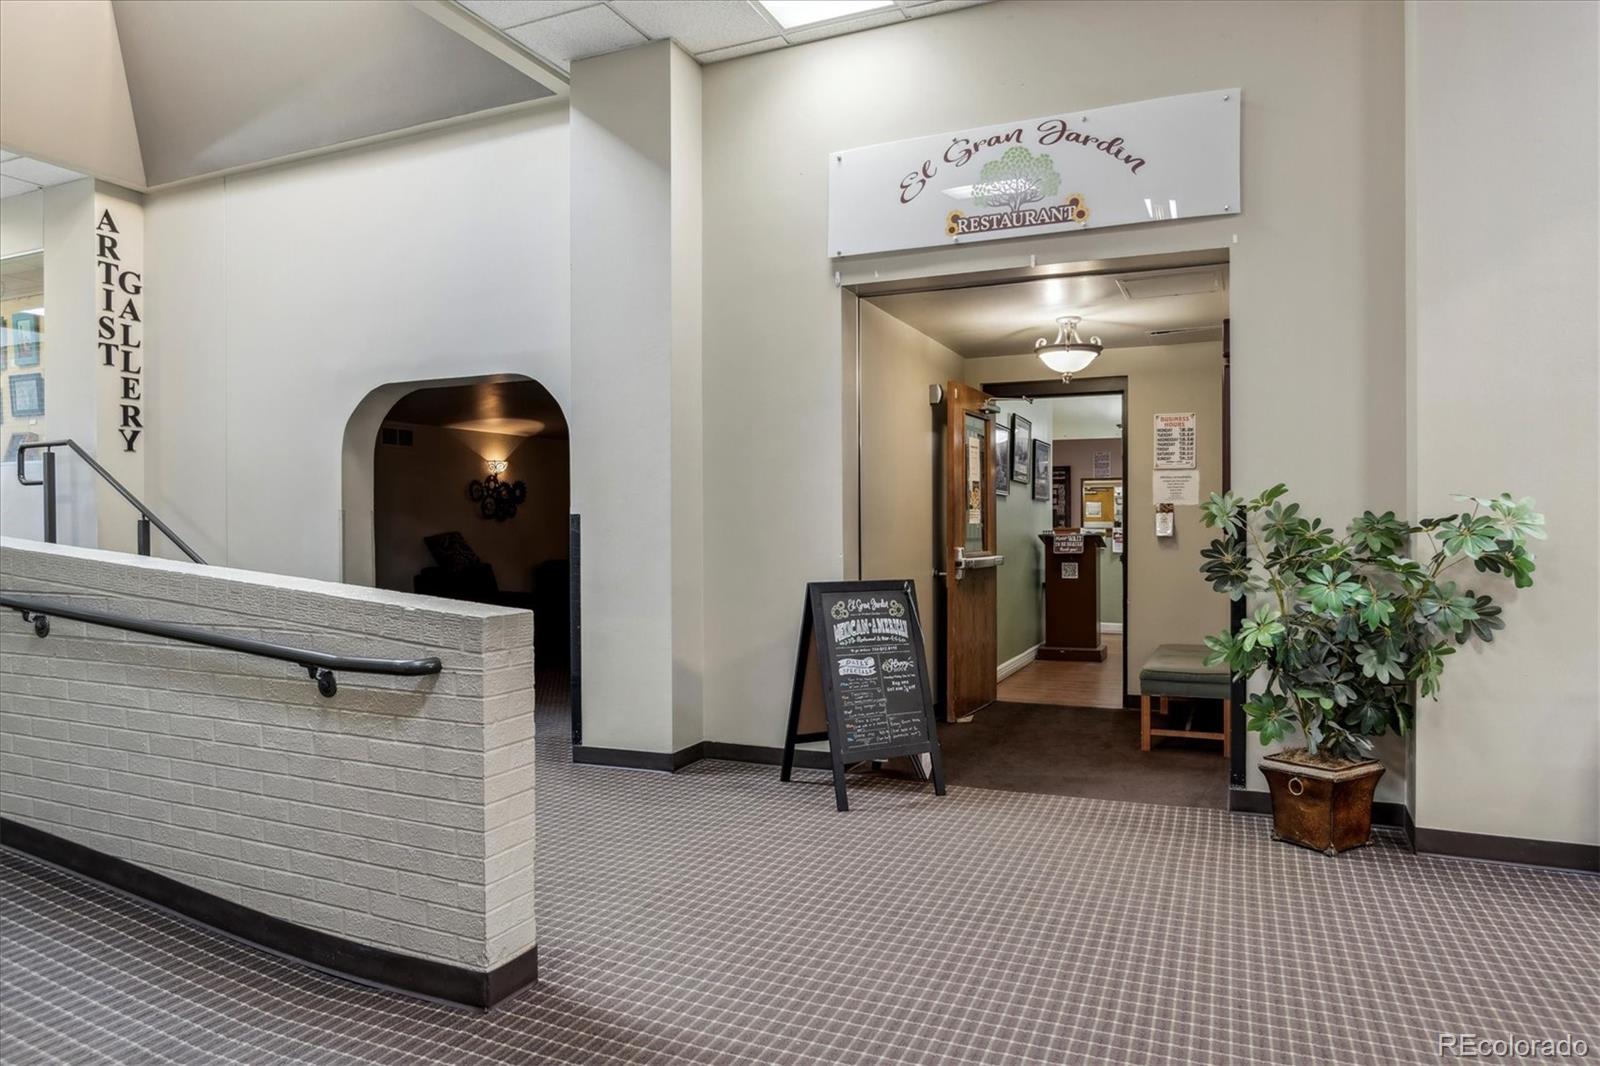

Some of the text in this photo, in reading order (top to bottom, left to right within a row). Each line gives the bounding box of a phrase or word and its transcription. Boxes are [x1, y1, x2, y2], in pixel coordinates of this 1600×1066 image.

[899, 118, 1147, 204] El Gran Jardin
[957, 204, 1077, 235] RESTAURANT
[96, 209, 121, 367] ARTIST
[118, 271, 143, 453] GALLERY
